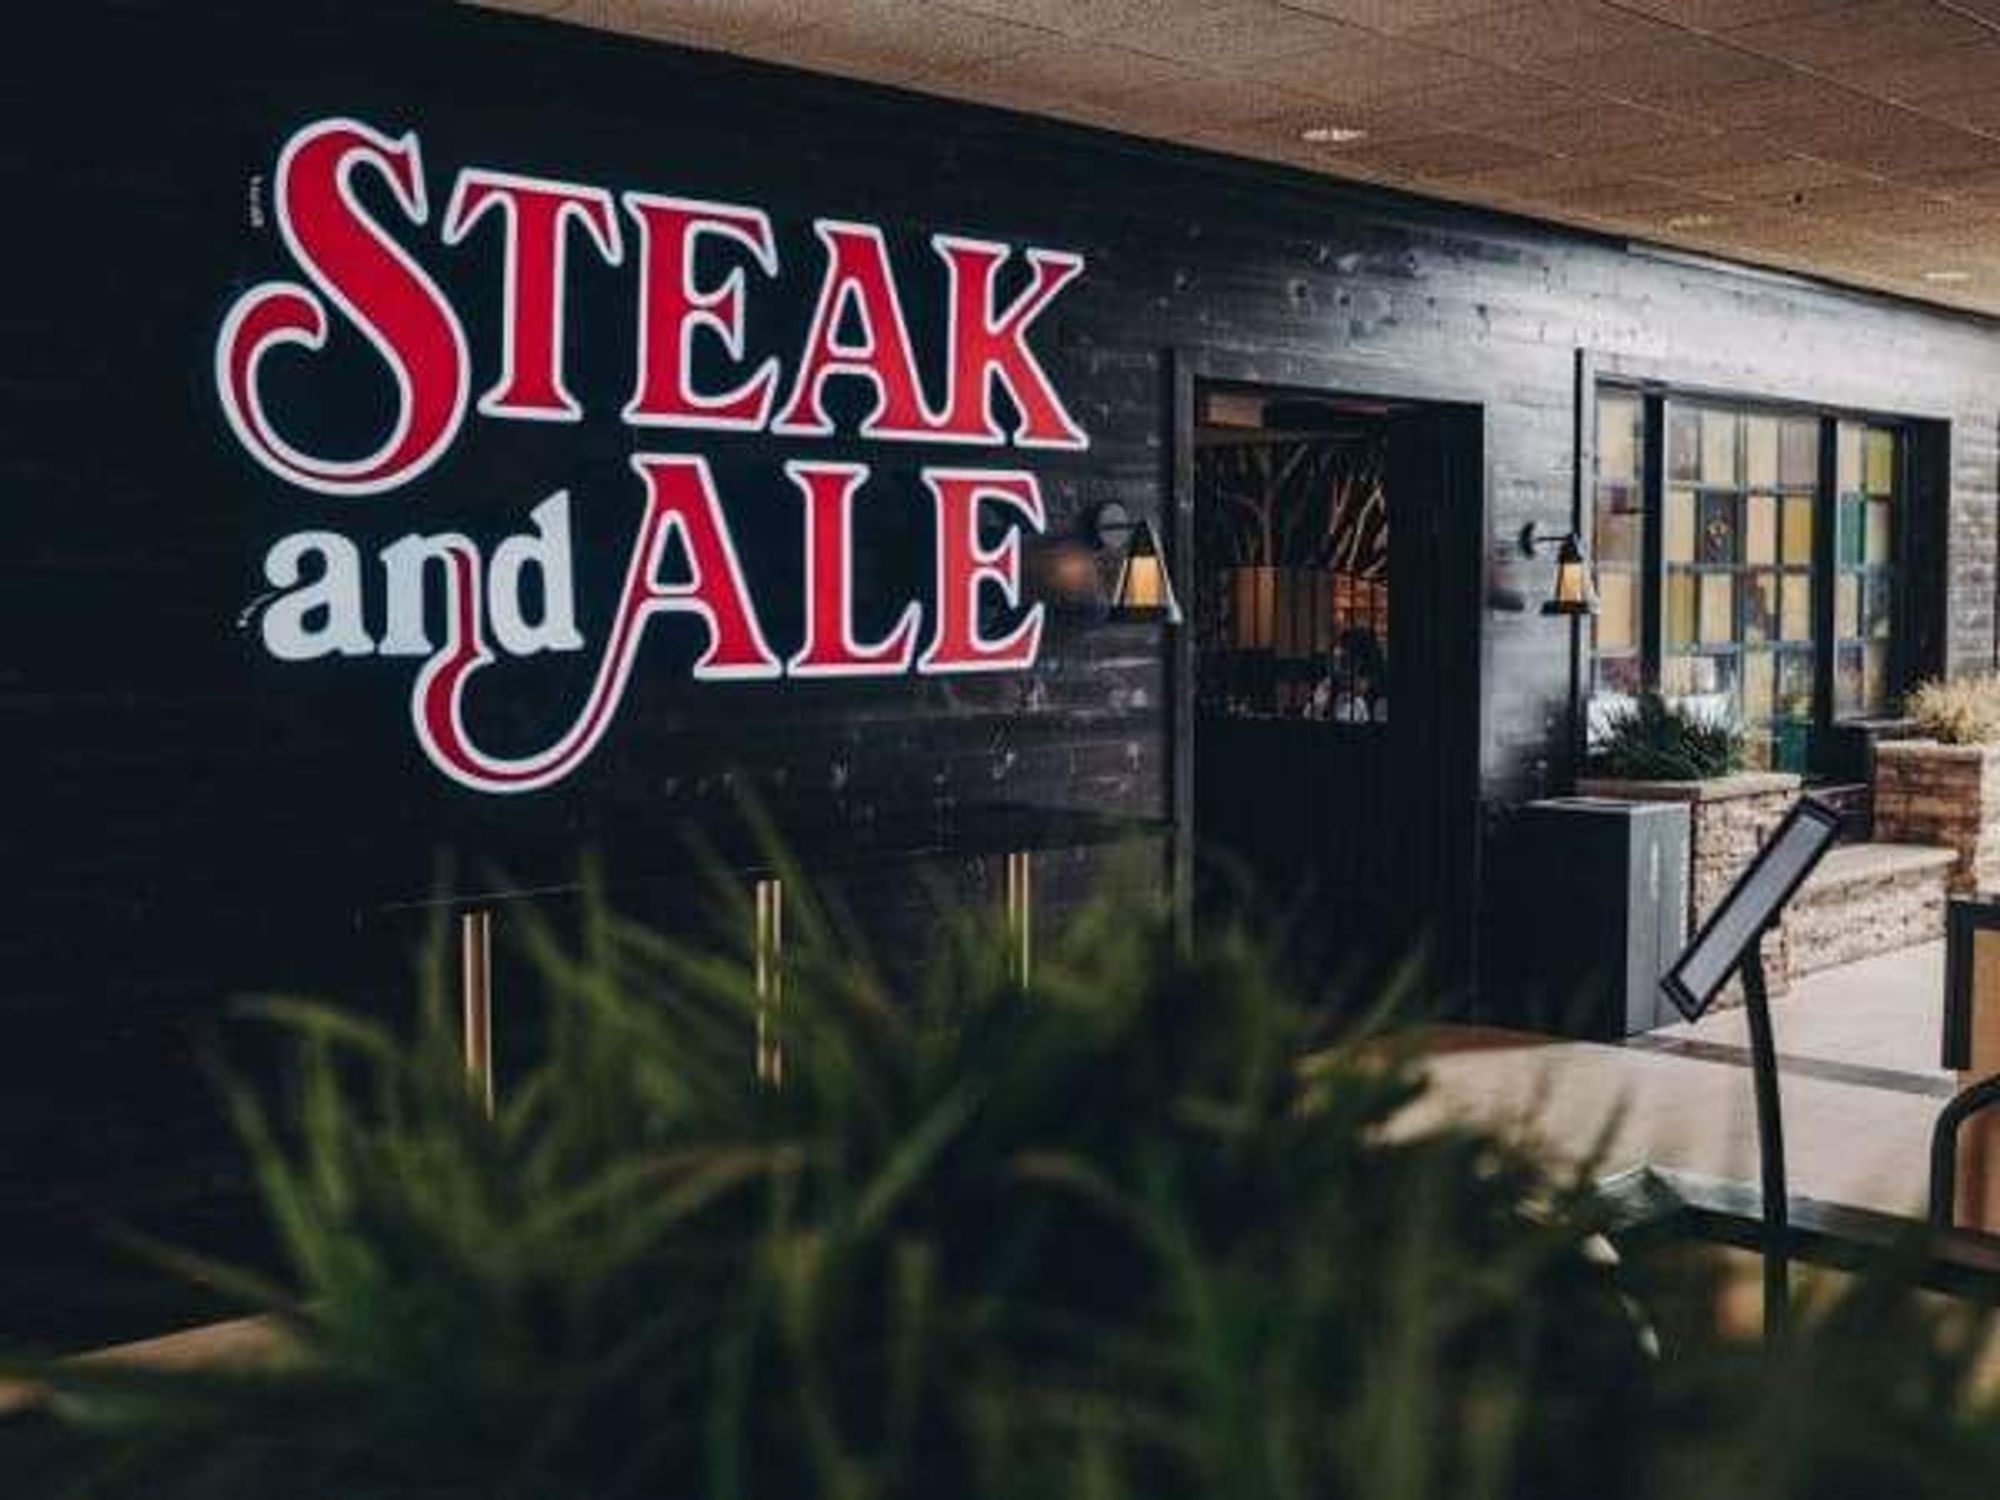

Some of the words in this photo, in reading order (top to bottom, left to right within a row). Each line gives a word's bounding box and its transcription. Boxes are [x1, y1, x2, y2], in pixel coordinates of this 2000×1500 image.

[215, 117, 1089, 497] STEAK
[261, 488, 585, 671] and
[530, 452, 1046, 775] ALE
